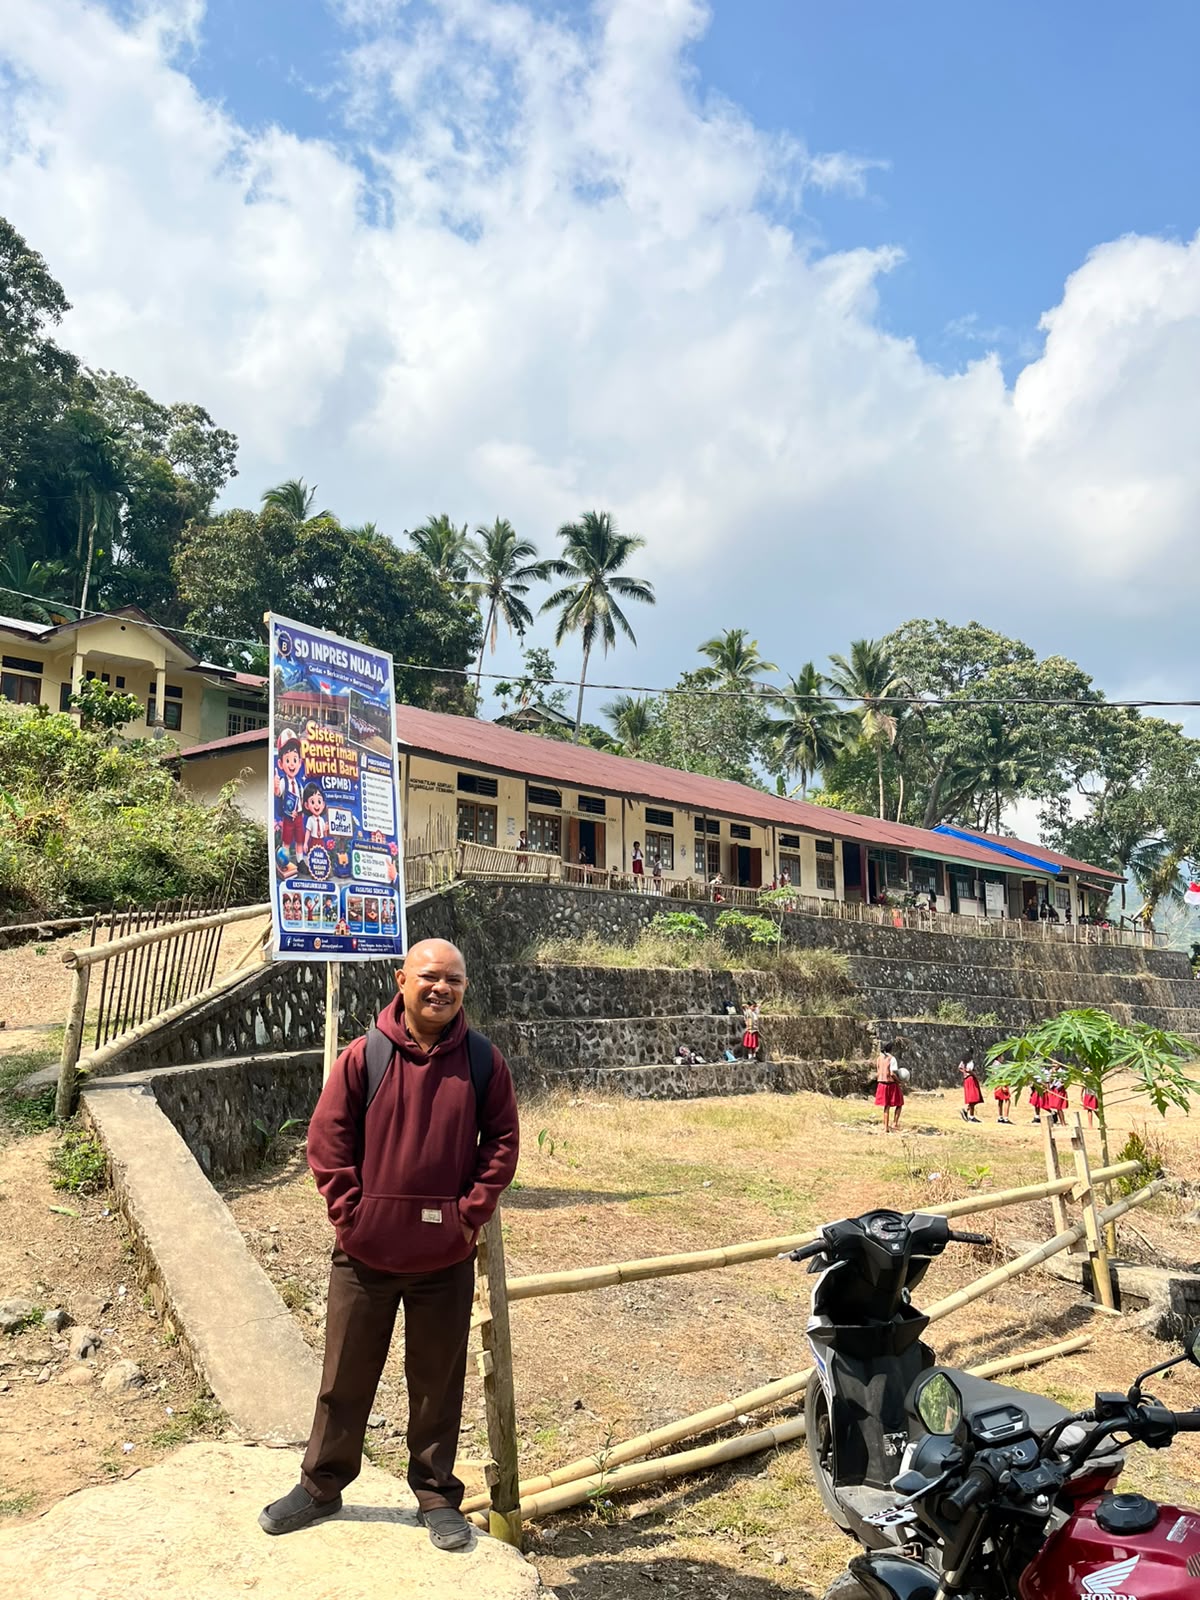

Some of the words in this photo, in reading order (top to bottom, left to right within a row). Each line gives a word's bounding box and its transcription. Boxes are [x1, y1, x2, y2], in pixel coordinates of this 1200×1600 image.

[294, 638, 309, 658] SD
[311, 642, 349, 669] INPRES
[350, 654, 384, 683] NUAJA
[306, 720, 344, 744] Sistem
[301, 739, 358, 761] Peneriman
[305, 757, 337, 774] Murid
[339, 759, 359, 777] Baru
[321, 775, 352, 791] (SPMB)
[330, 821, 352, 833] Daftar!
[335, 811, 347, 823] Ayo
